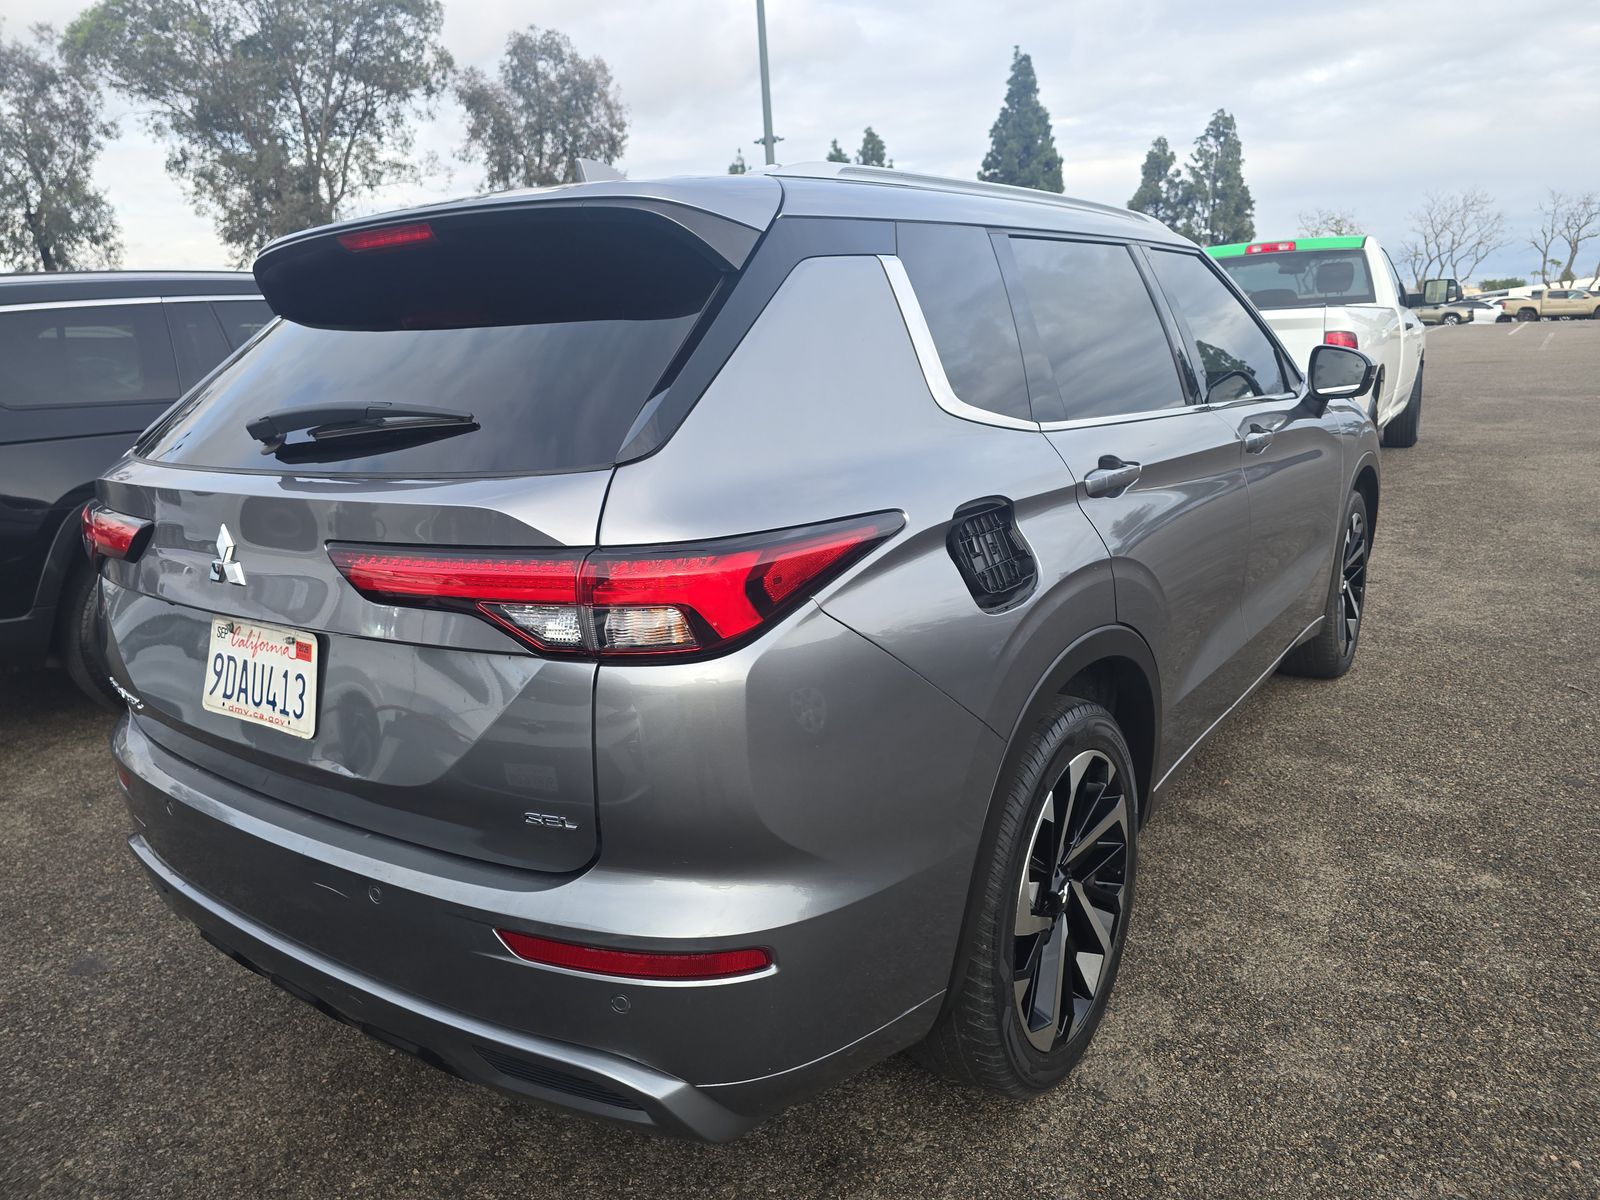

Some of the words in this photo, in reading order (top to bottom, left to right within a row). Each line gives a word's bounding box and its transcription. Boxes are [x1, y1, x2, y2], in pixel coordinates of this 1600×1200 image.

[217, 626, 229, 639] SEP
[231, 626, 297, 660] California
[209, 652, 307, 720] 9DAU413
[228, 704, 286, 726] dmv.ca.gov
[524, 812, 578, 829] SEL
